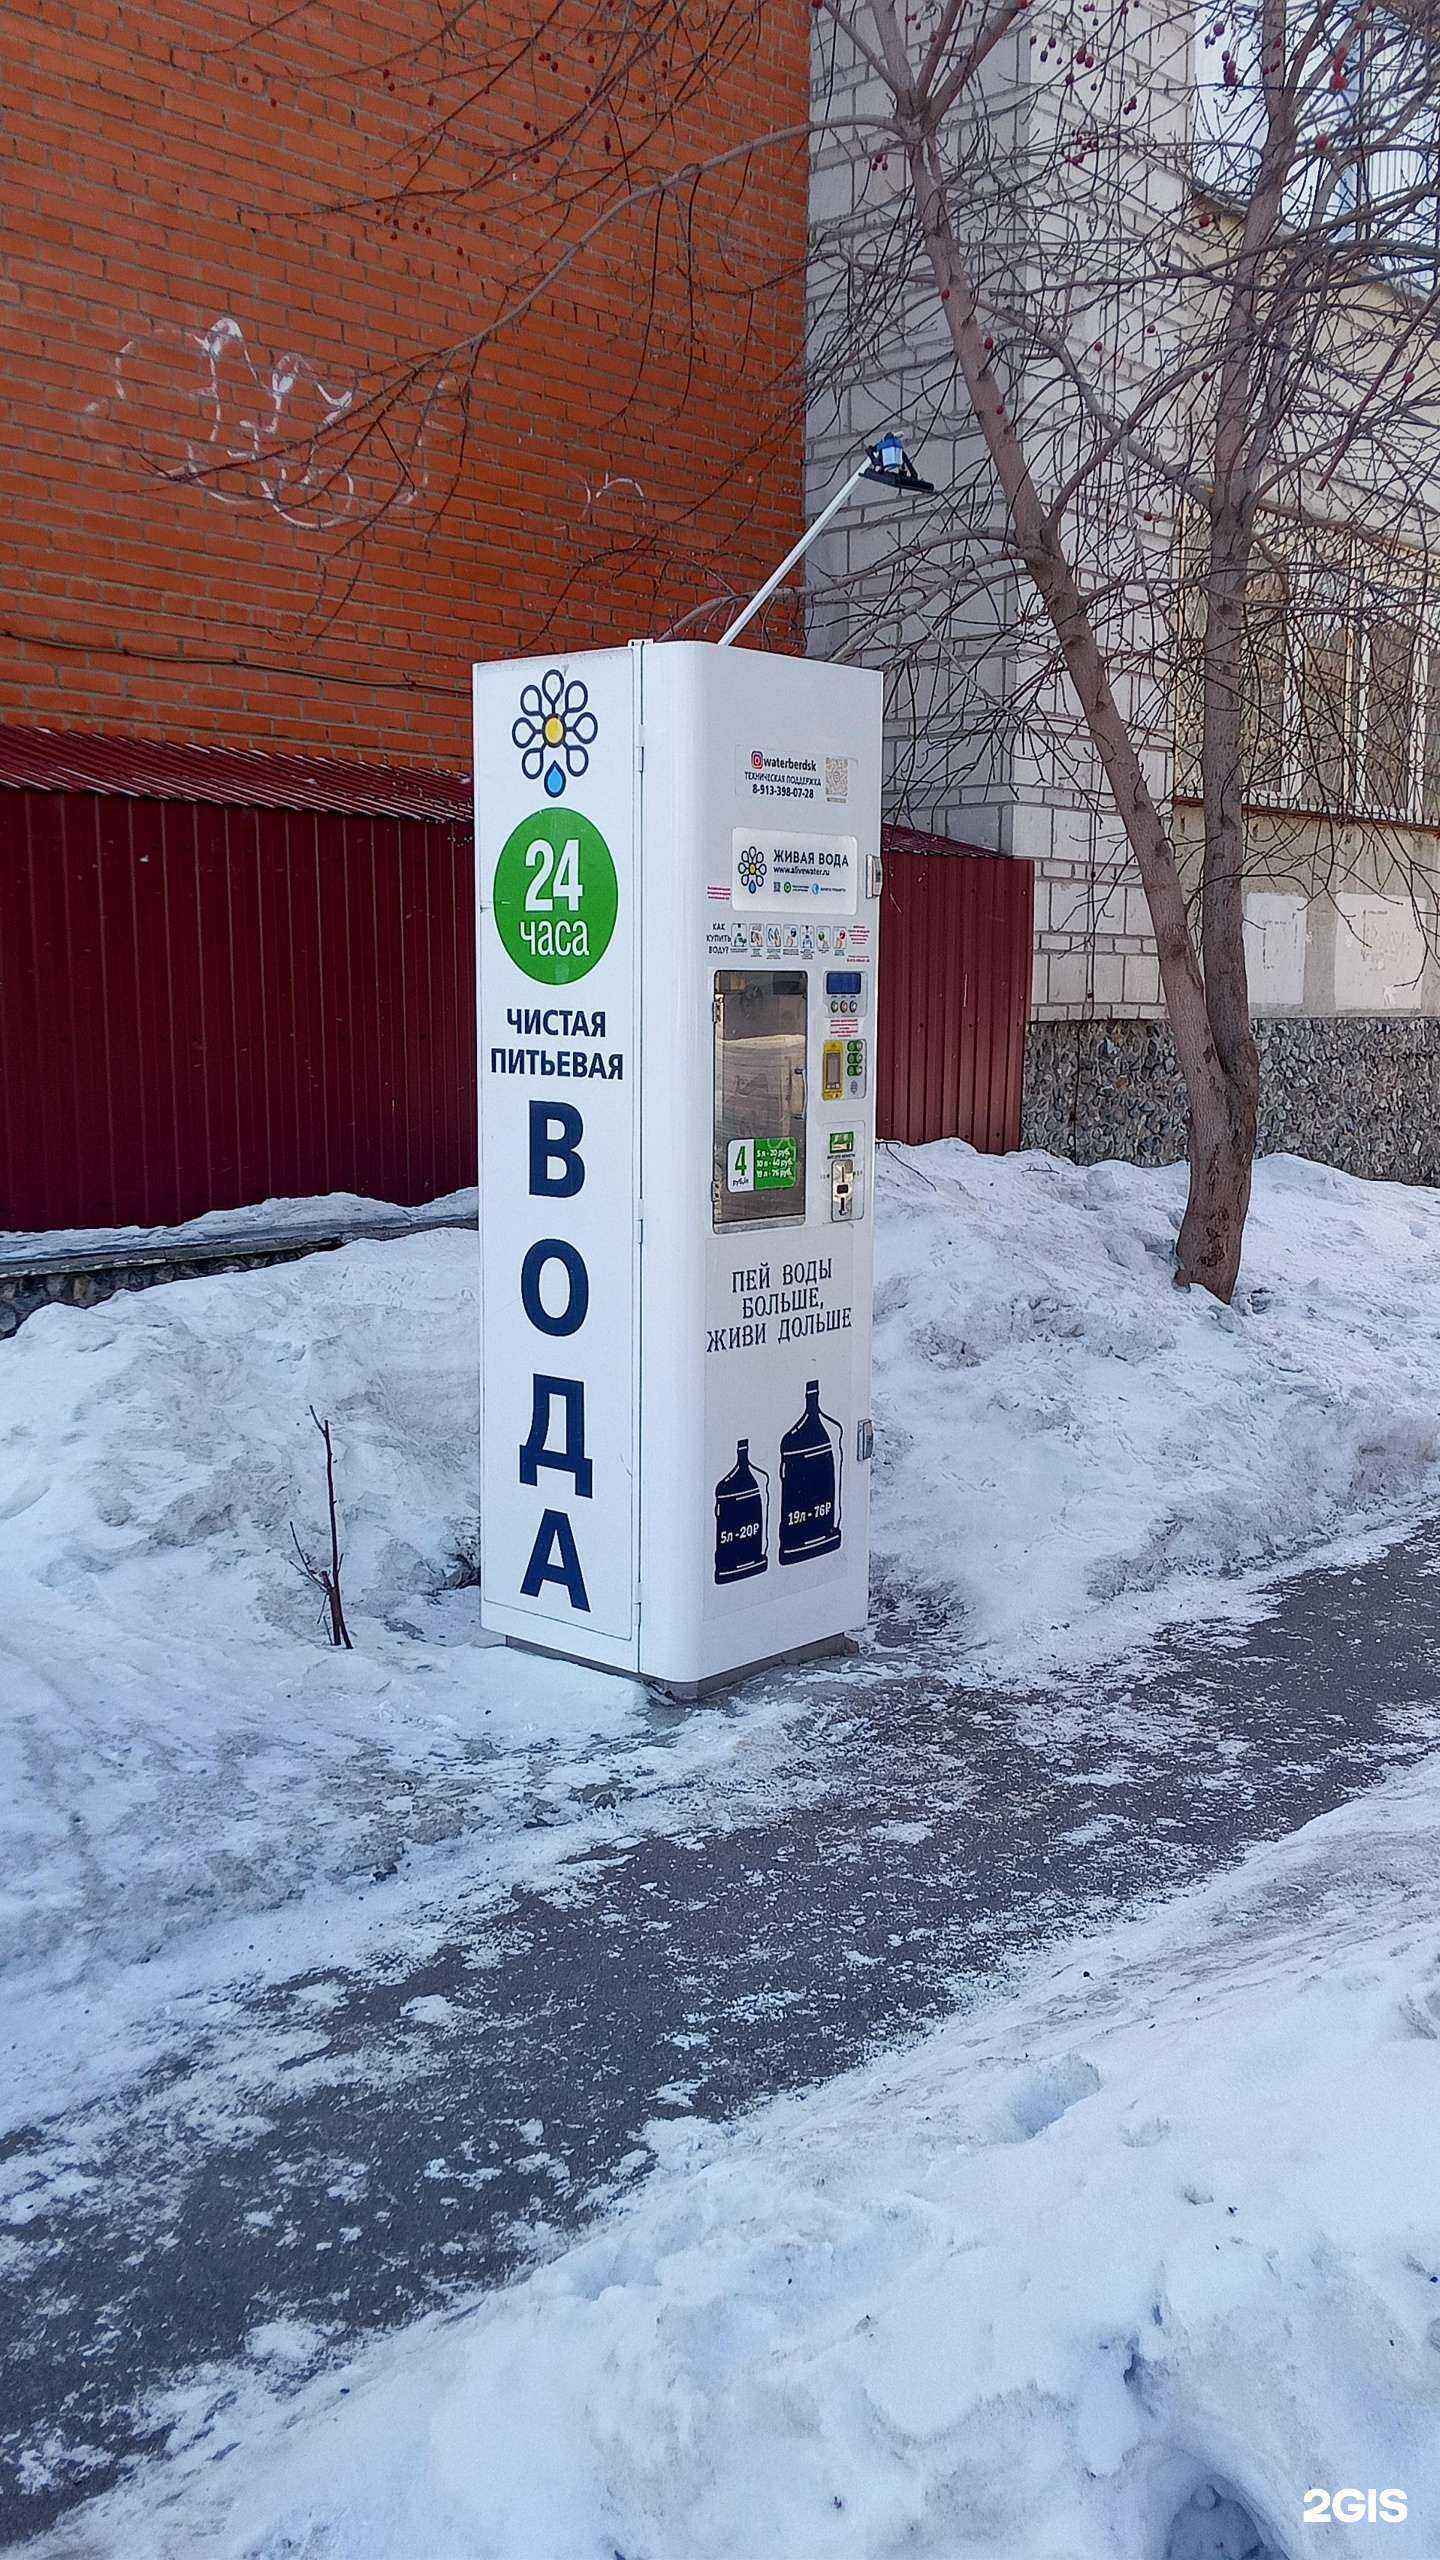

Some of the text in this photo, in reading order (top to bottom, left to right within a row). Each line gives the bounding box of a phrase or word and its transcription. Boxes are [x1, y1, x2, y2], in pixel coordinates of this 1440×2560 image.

[744, 771, 822, 787] ТЕХНИЧЕСКАЯ ПОДДЕРЖКА
[763, 757, 817, 772] waterberdsk
[752, 783, 814, 799] 8-913-398-07-28
[773, 849, 849, 868] ЖИВАЯ ВОДА
[525, 839, 584, 912] 24
[519, 920, 590, 956] часа
[706, 935, 732, 943] КУПИТЬ
[712, 922, 726, 931] КАК
[708, 945, 729, 955] ВОДУ?
[506, 1008, 606, 1038] ЧИСТАЯ
[490, 1047, 624, 1080] ПИТЬЕВАЯ
[735, 1145, 747, 1176] 4
[732, 1258, 832, 1293] ПЕЙ ВОДЫ
[742, 1287, 824, 1319] БОЛЬШЕ,
[706, 1307, 852, 1352] ЖИВИ ДОЛЬШЕ
[519, 1099, 593, 1613] ВОДА
